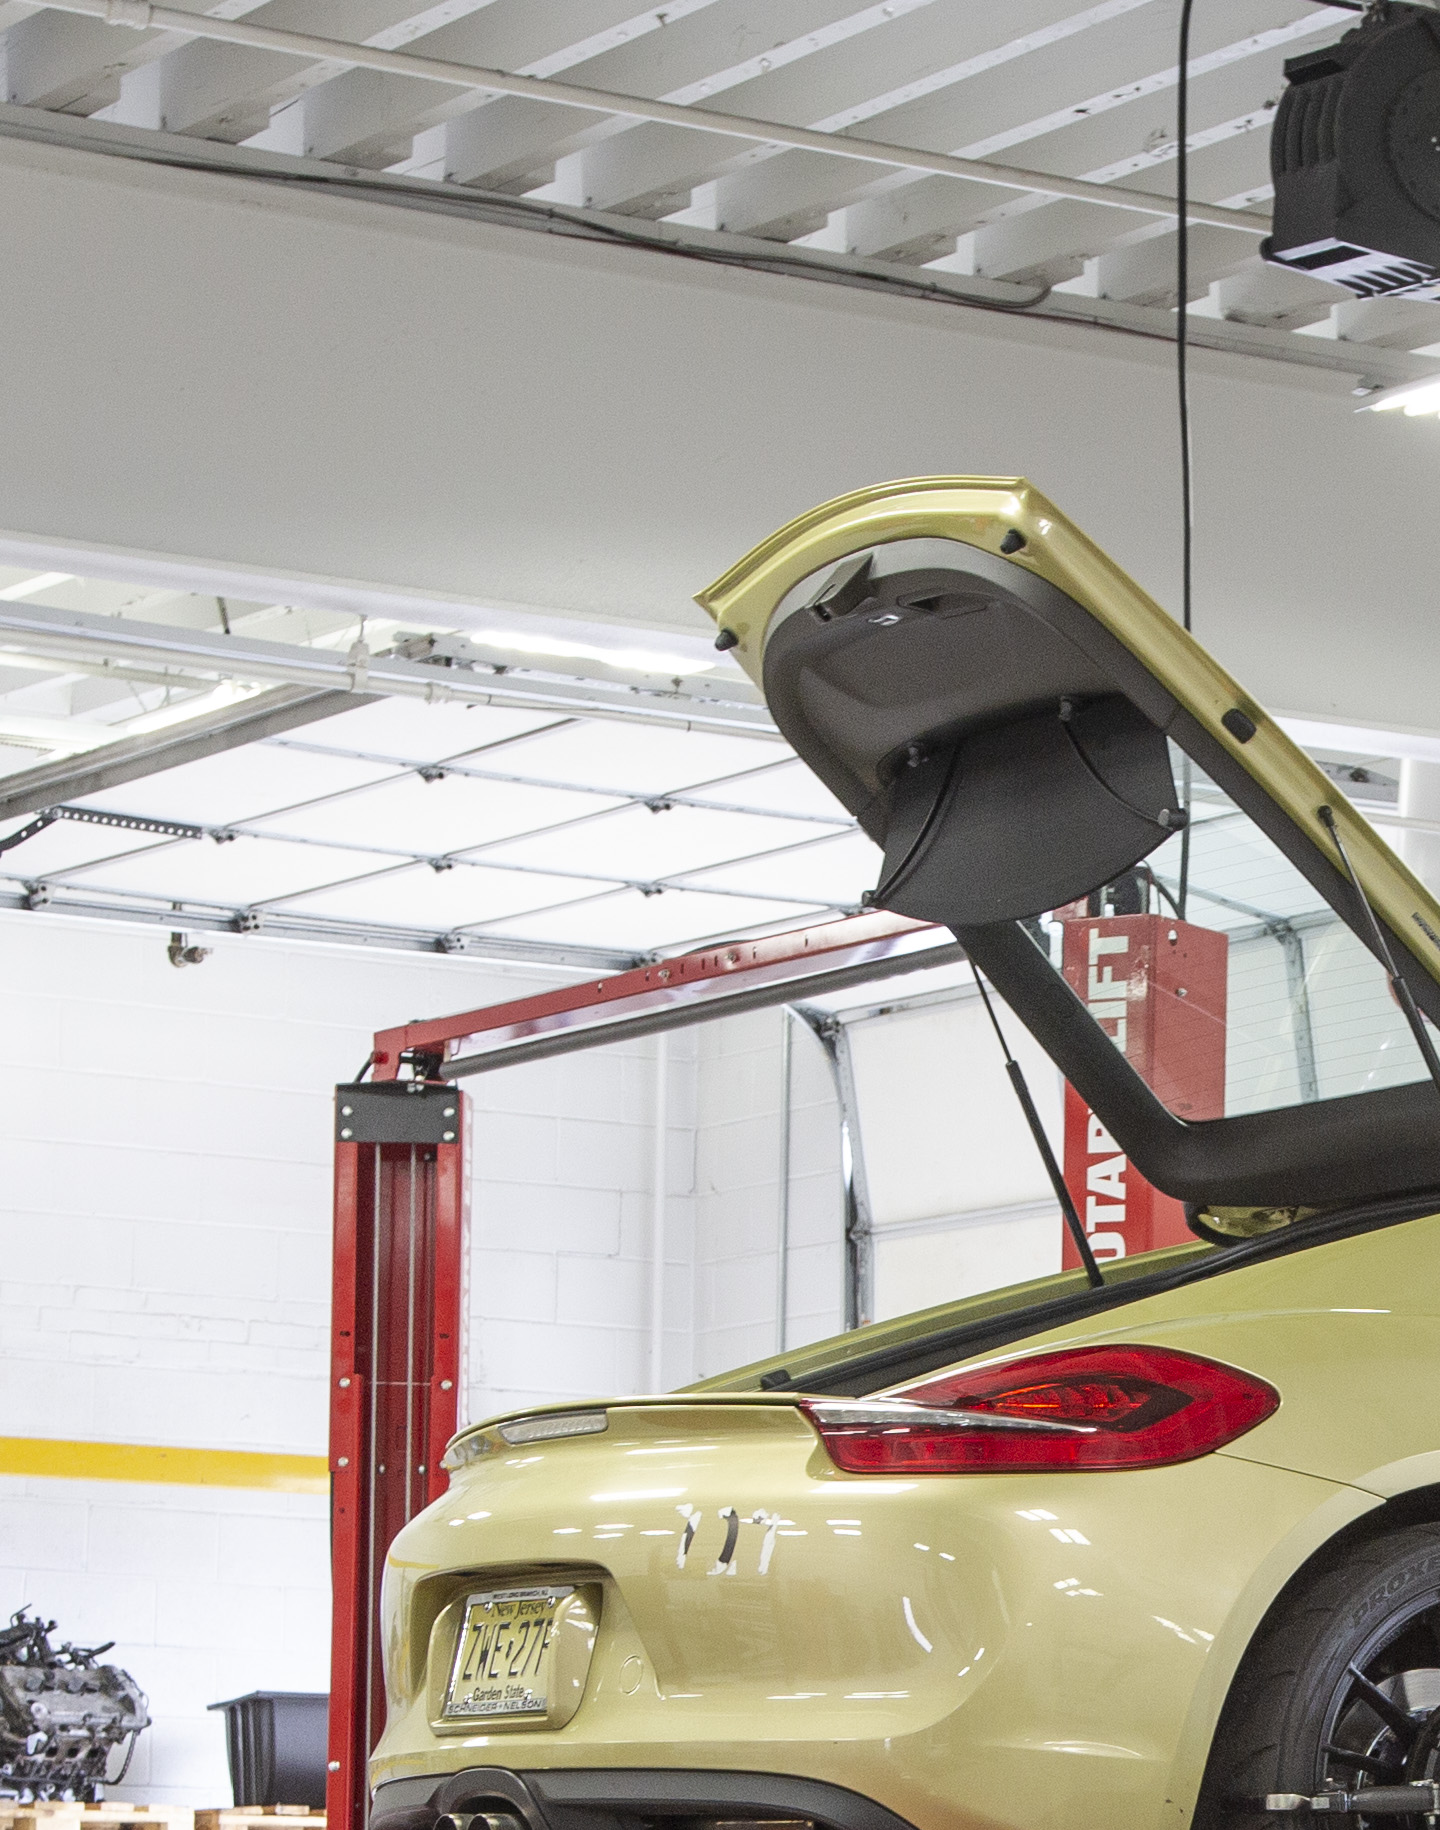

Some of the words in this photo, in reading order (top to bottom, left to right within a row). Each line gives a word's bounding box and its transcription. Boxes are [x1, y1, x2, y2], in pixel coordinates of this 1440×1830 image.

[1086, 1106, 1127, 1264] OTAR
[491, 1603, 513, 1618] New
[514, 1601, 546, 1620] Jersey
[472, 1685, 502, 1702] Garden
[504, 1684, 525, 1699] State
